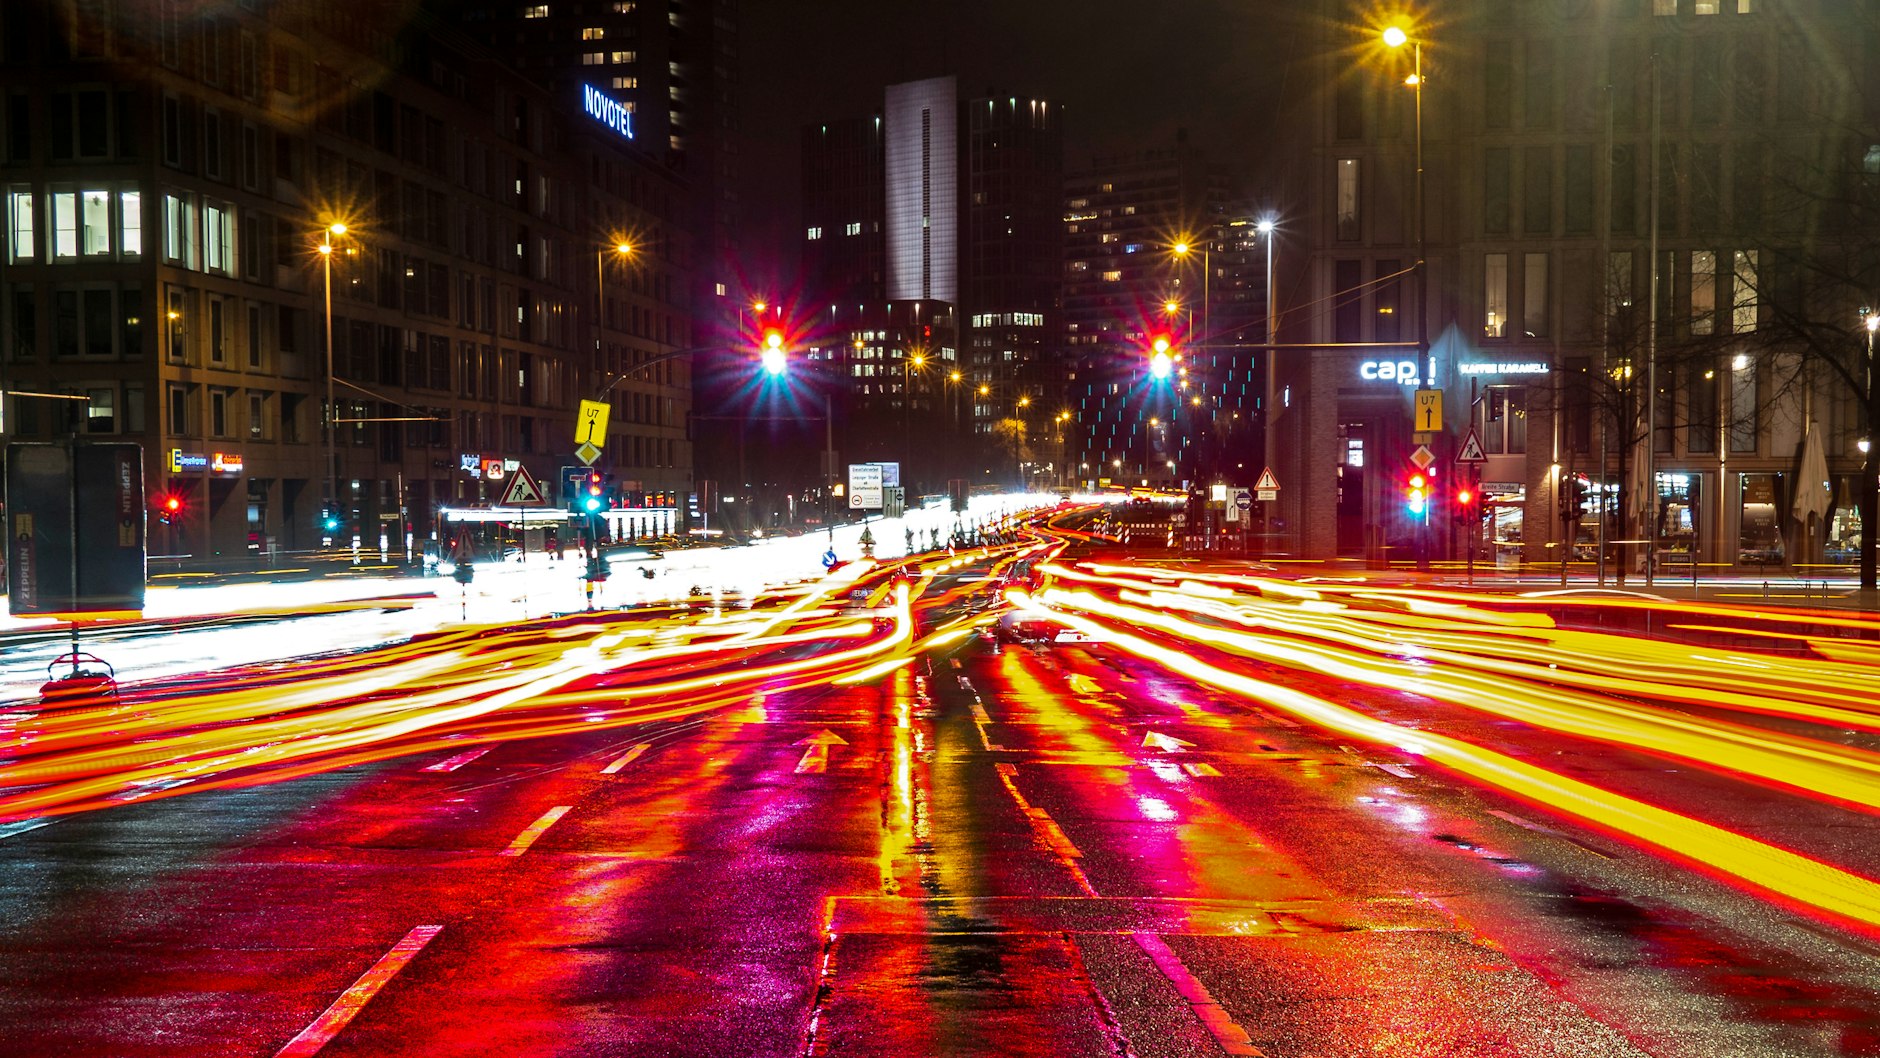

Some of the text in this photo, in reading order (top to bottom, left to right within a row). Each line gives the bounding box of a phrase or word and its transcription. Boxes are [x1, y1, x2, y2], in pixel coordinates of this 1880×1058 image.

[585, 83, 633, 139] NOVOTEL
[1360, 356, 1437, 385] capi
[586, 408, 600, 418] U7
[1421, 395, 1436, 405] U7
[120, 461, 132, 513] ZEPPELIN
[1499, 483, 1515, 491] Straße
[20, 547, 30, 599] ZEPPELIN
